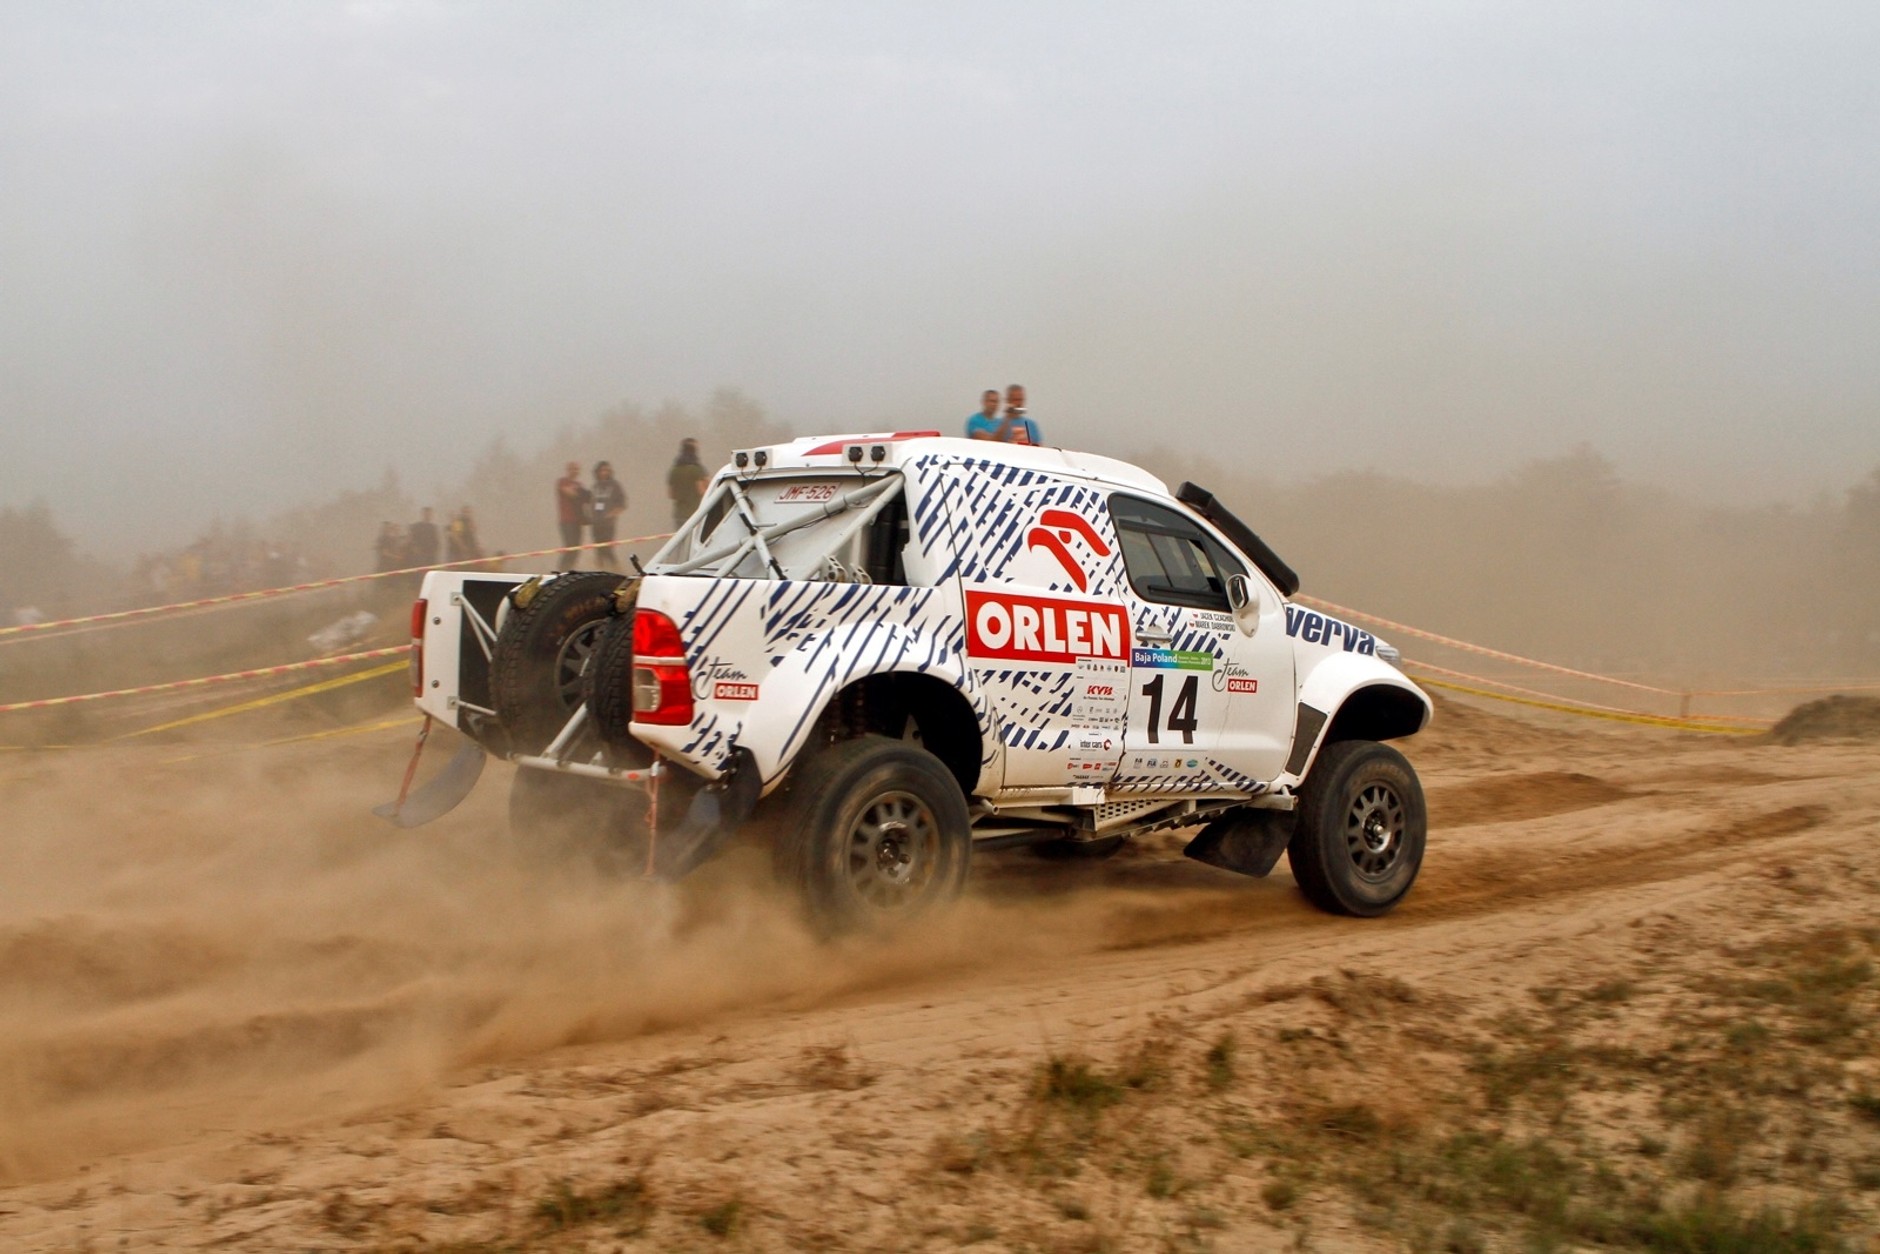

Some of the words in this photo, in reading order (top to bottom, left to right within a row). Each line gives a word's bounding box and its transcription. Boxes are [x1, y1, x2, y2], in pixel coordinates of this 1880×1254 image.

[780, 485, 836, 500] JMF-526
[976, 601, 1121, 657] ORLEN
[1285, 606, 1376, 657] verva
[1135, 652, 1151, 664] Baja
[1152, 653, 1178, 663] Poland
[716, 685, 757, 699] ORLEN
[1087, 685, 1113, 695] KYB
[1229, 680, 1256, 691] ORLEN
[1142, 674, 1198, 744] 14
